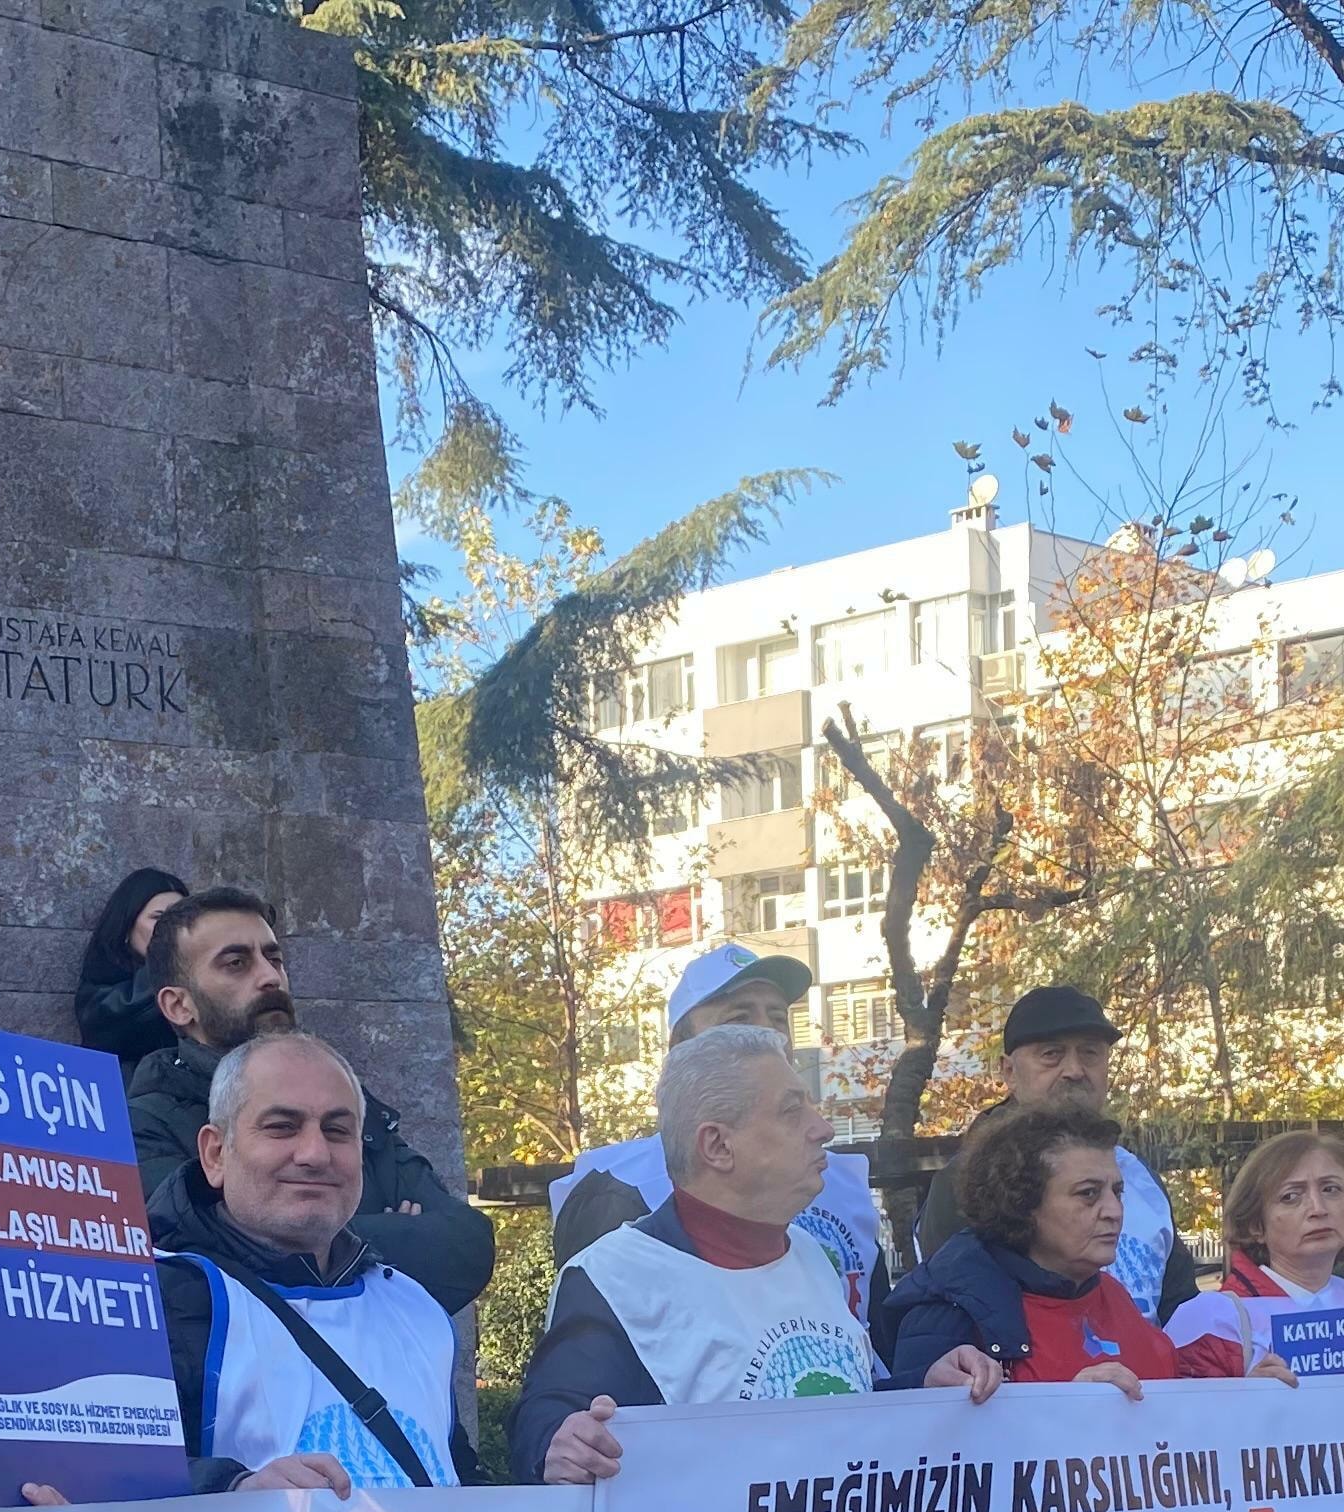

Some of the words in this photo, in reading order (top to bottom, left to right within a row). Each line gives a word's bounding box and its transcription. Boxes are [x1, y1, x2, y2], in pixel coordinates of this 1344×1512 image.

[94, 626, 180, 658] KEMAL
[15, 1054, 106, 1136] İÇİN
[1, 1259, 159, 1330] HİZMETİ
[1283, 1320, 1333, 1343] KATKI,
[25, 1400, 40, 1415] VE
[42, 1402, 84, 1417] SOSYAL
[86, 1401, 121, 1419] HİZMET
[57, 1418, 86, 1436] (SES)
[88, 1420, 135, 1436] TRABZON
